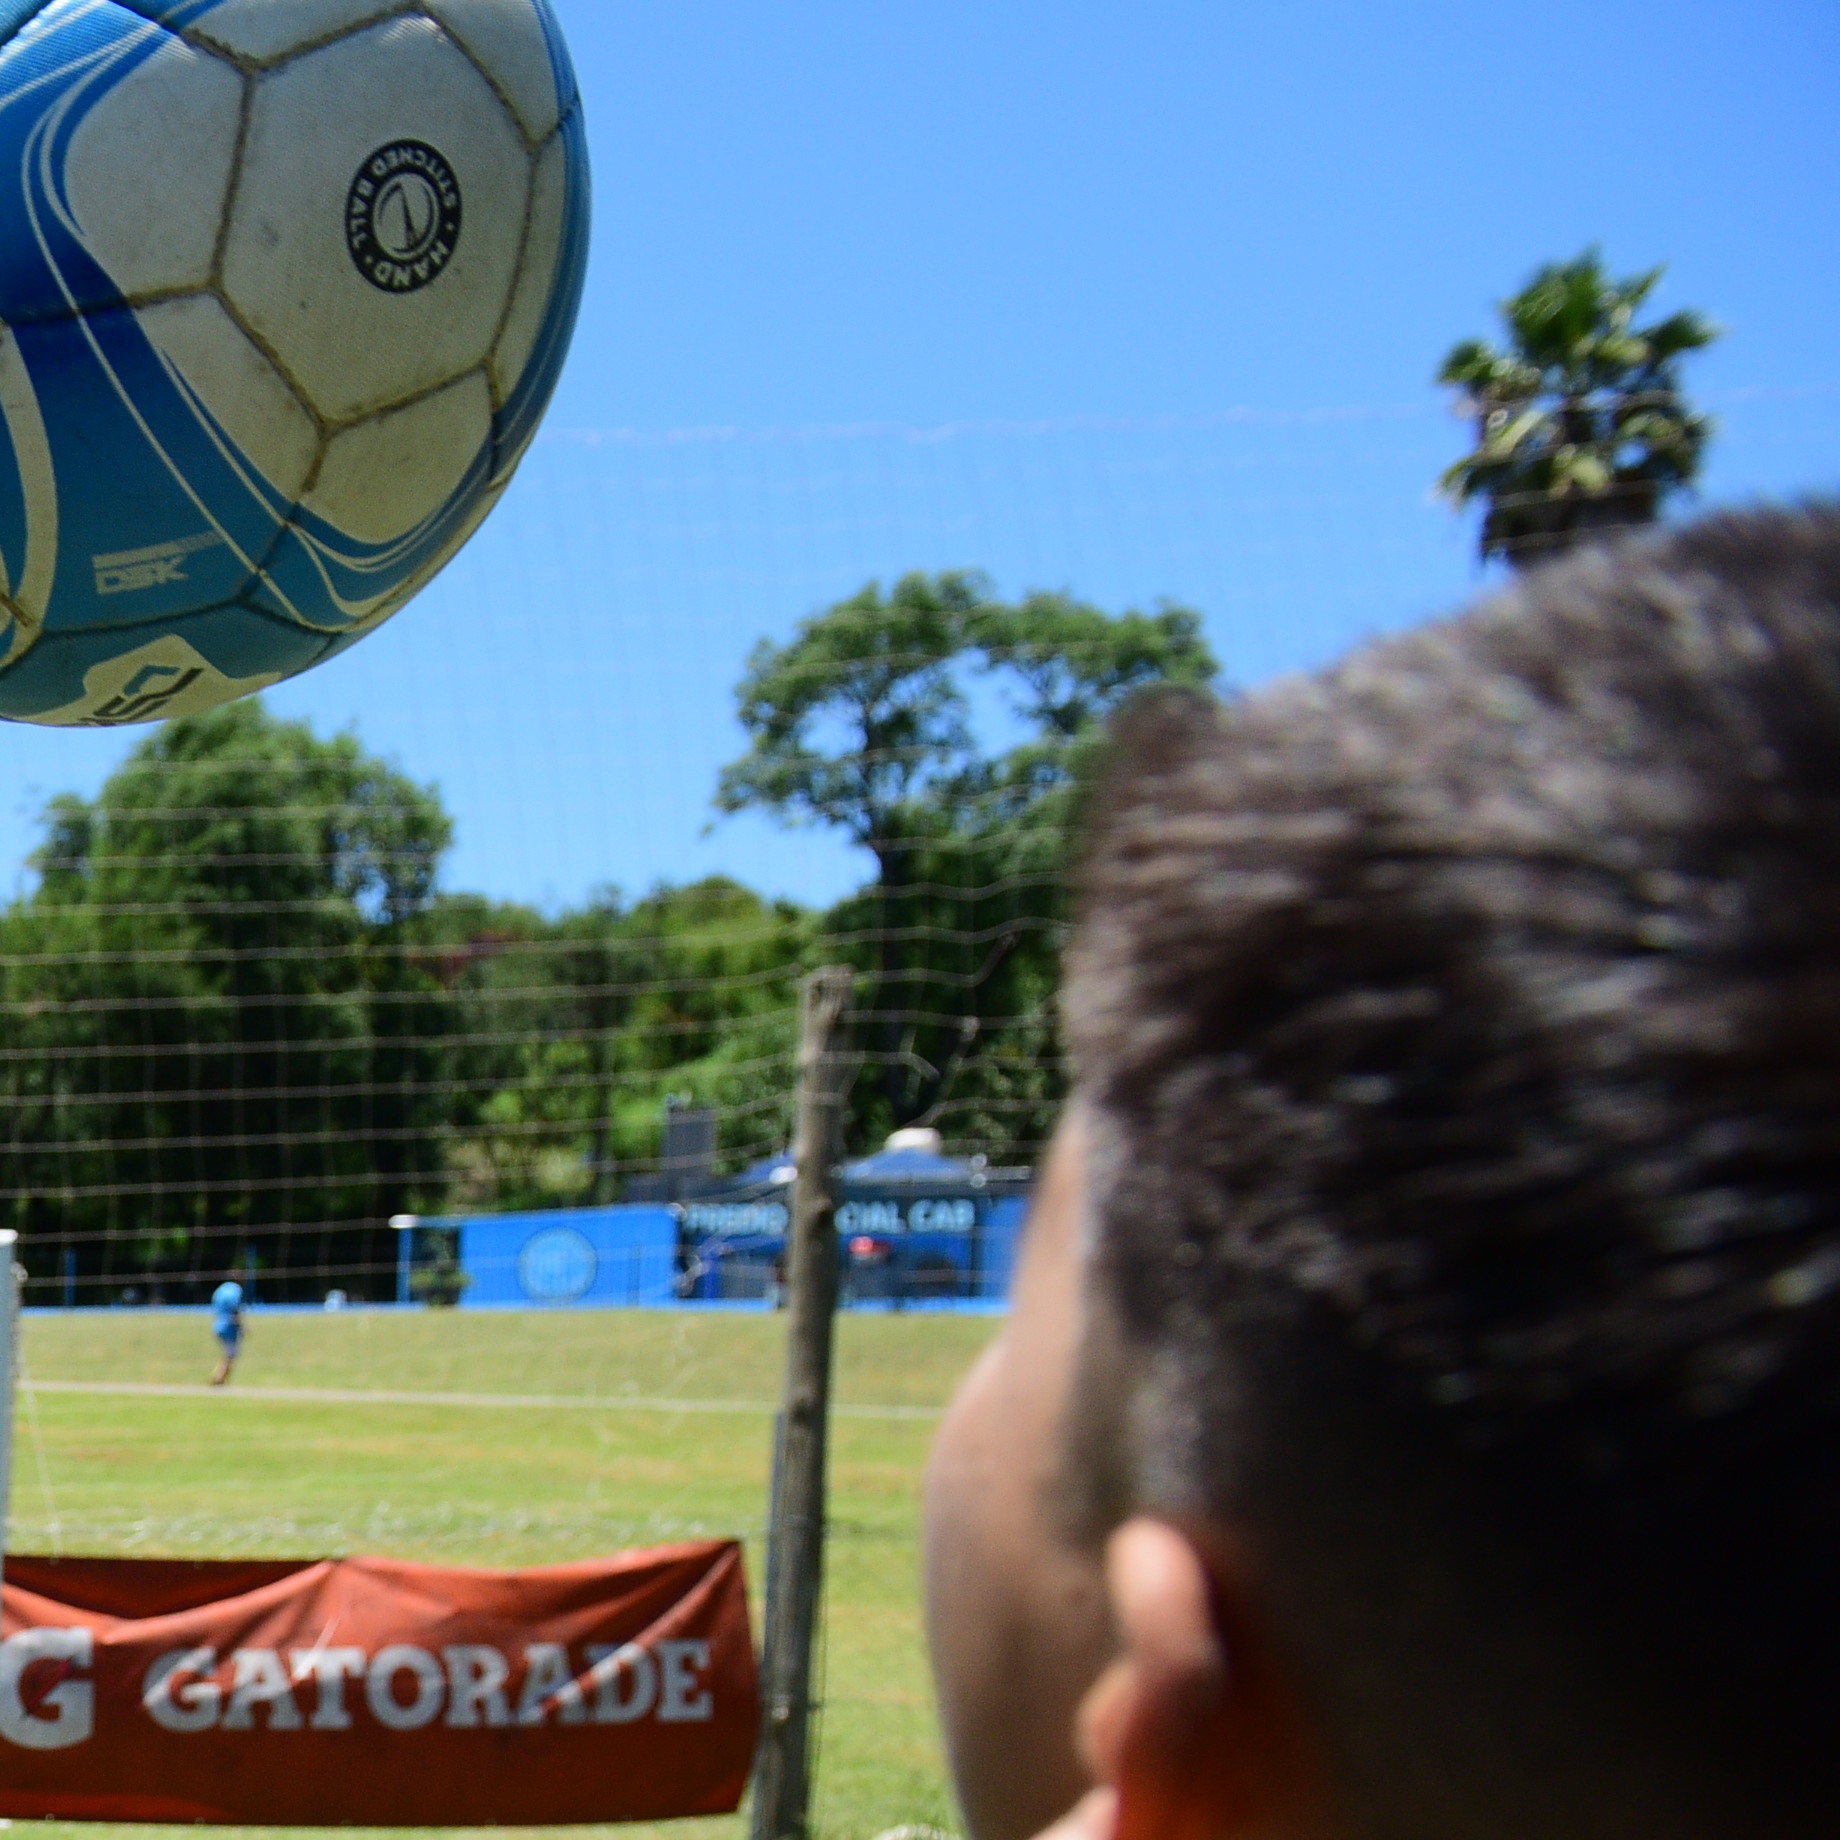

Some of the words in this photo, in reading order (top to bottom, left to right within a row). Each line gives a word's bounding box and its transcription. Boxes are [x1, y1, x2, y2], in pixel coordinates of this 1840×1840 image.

[349, 177, 375, 249] BALL
[373, 240, 450, 287] HAND
[142, 1638, 716, 1732] GATORADE
